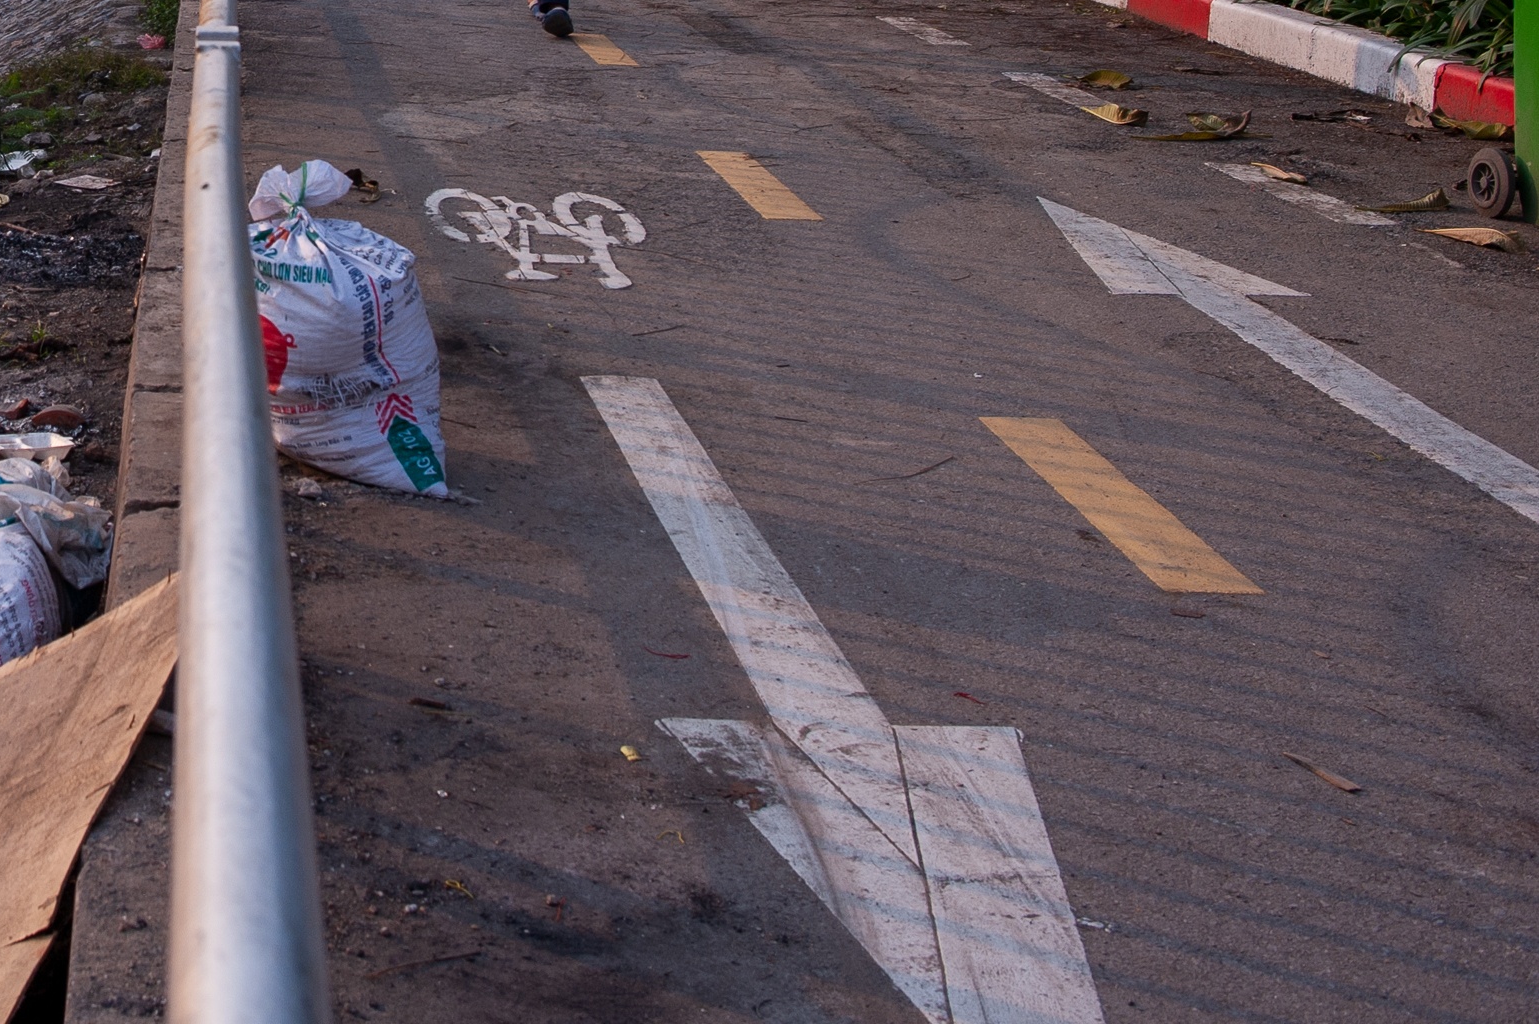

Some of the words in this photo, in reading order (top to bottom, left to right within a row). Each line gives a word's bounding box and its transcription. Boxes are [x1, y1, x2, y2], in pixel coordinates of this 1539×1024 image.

[362, 301, 375, 322] CAO
[398, 427, 421, 451] 102
[417, 455, 438, 477] AG
